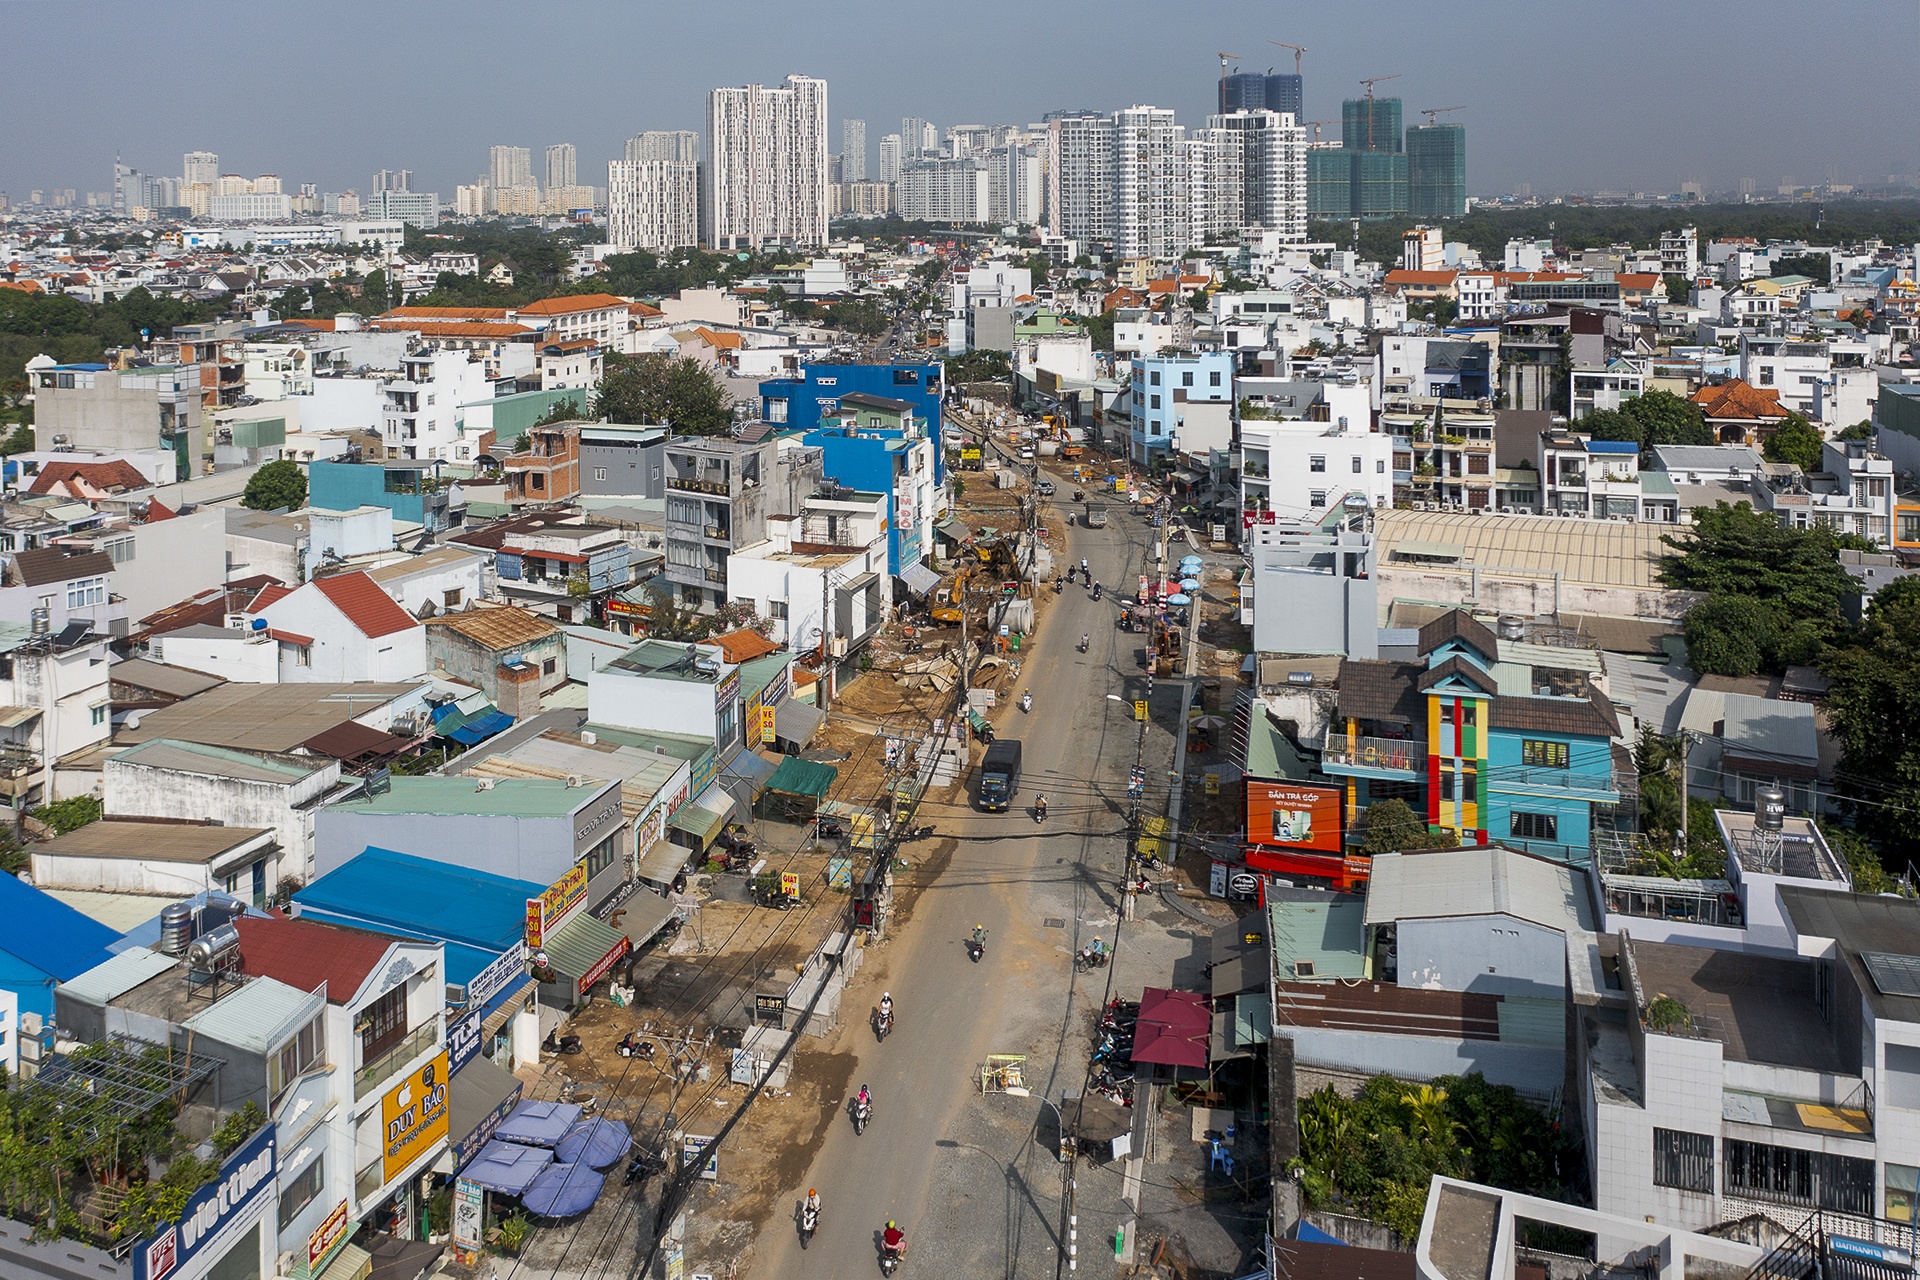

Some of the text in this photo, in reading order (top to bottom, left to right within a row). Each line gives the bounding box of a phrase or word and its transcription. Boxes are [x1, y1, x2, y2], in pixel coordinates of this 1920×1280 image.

[1302, 793, 1319, 802] GÓP
[455, 1034, 480, 1062] COFFEE
[388, 1104, 417, 1142] DUY
[422, 1082, 447, 1116] BẢO
[181, 1147, 272, 1250] viettien
